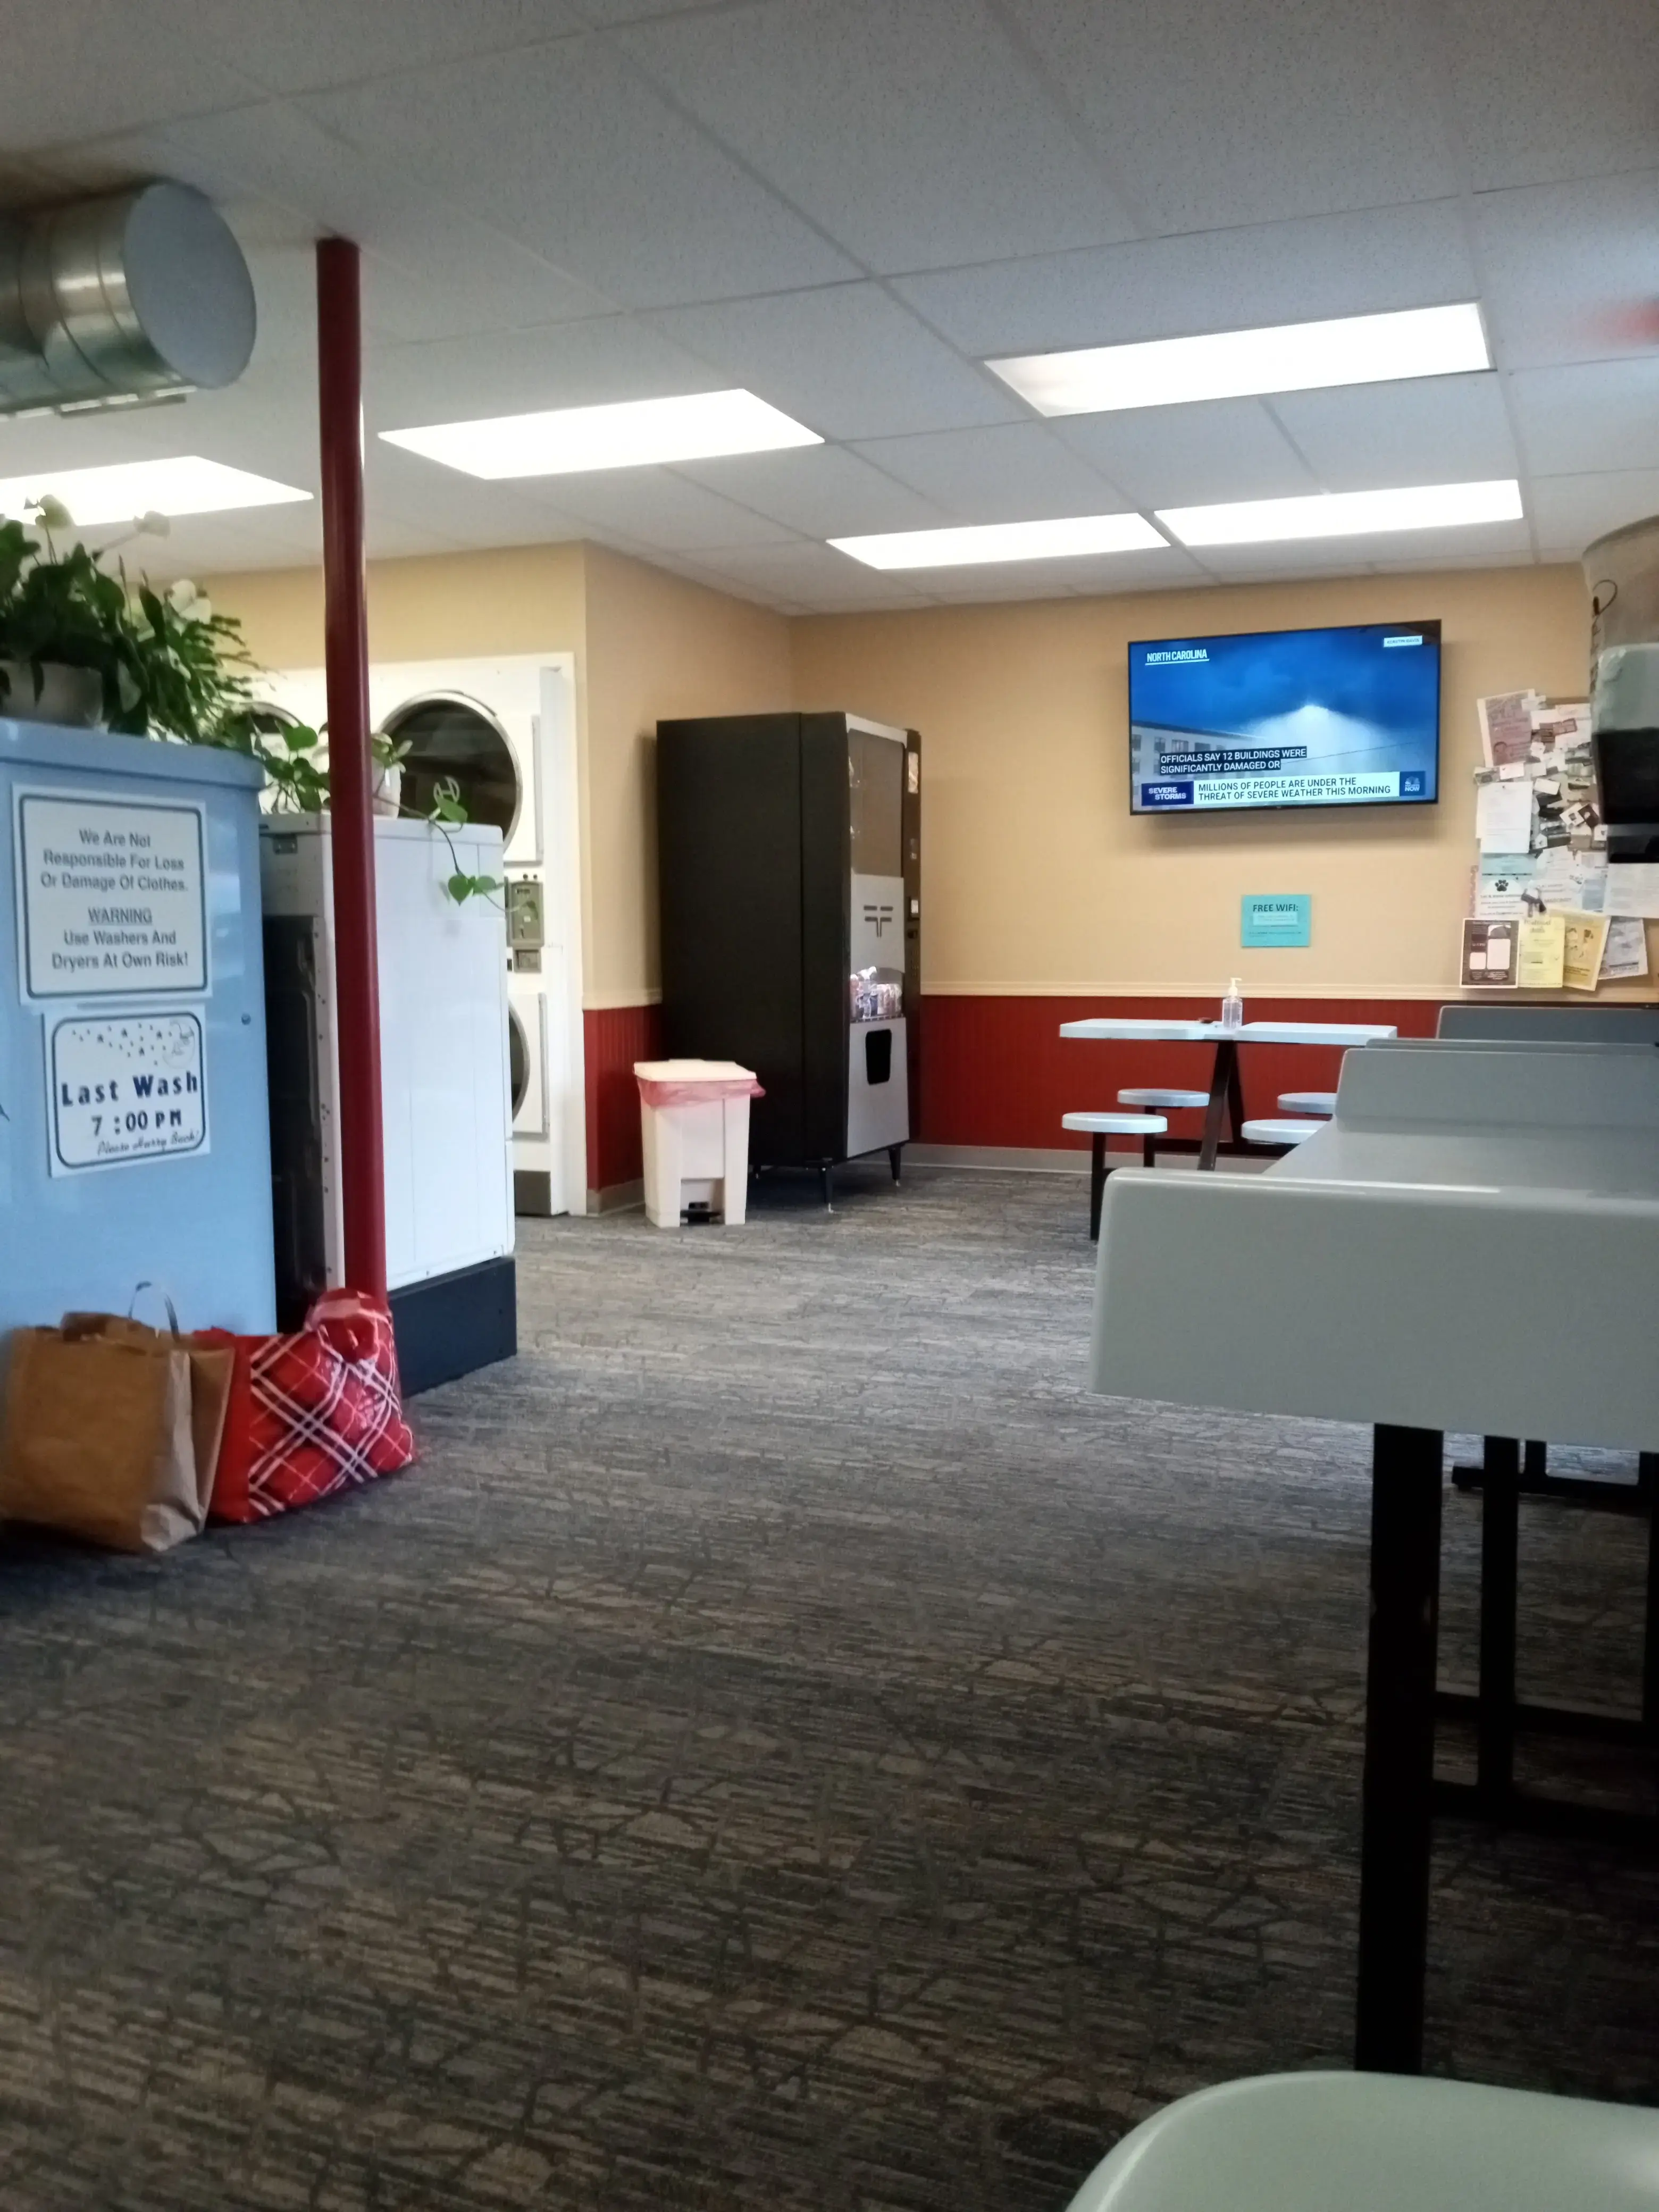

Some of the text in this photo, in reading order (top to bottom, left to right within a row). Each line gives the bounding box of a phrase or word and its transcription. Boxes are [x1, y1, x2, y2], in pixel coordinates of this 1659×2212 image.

[1147, 649, 1208, 662] NORTH CAROLINA
[1161, 754, 1203, 764] OFFICIALS
[1204, 753, 1220, 761] SAY
[1235, 750, 1280, 760] BUILDINGS
[1281, 749, 1306, 758] WERE
[1161, 763, 1222, 774] SIGNIFICANTLY
[1224, 761, 1266, 770] DAMAGED
[1199, 782, 1238, 791] MILLIONS
[1254, 780, 1286, 789] PEOPLE
[1308, 778, 1336, 786] UNDER
[1200, 792, 1231, 801] THREAT
[1247, 790, 1279, 799] SEVERE
[1281, 789, 1322, 797] WEATHER
[1348, 785, 1391, 795] MORNING
[79, 829, 151, 848] We Are Not
[43, 849, 185, 870] Responsible For Loss
[40, 872, 188, 893] Or Damage Of Clothes.
[88, 907, 153, 924] WARNING
[64, 929, 177, 945] Use Washers And
[52, 951, 188, 973] Dryers At Own Risk!
[61, 1070, 198, 1107] Last Wash
